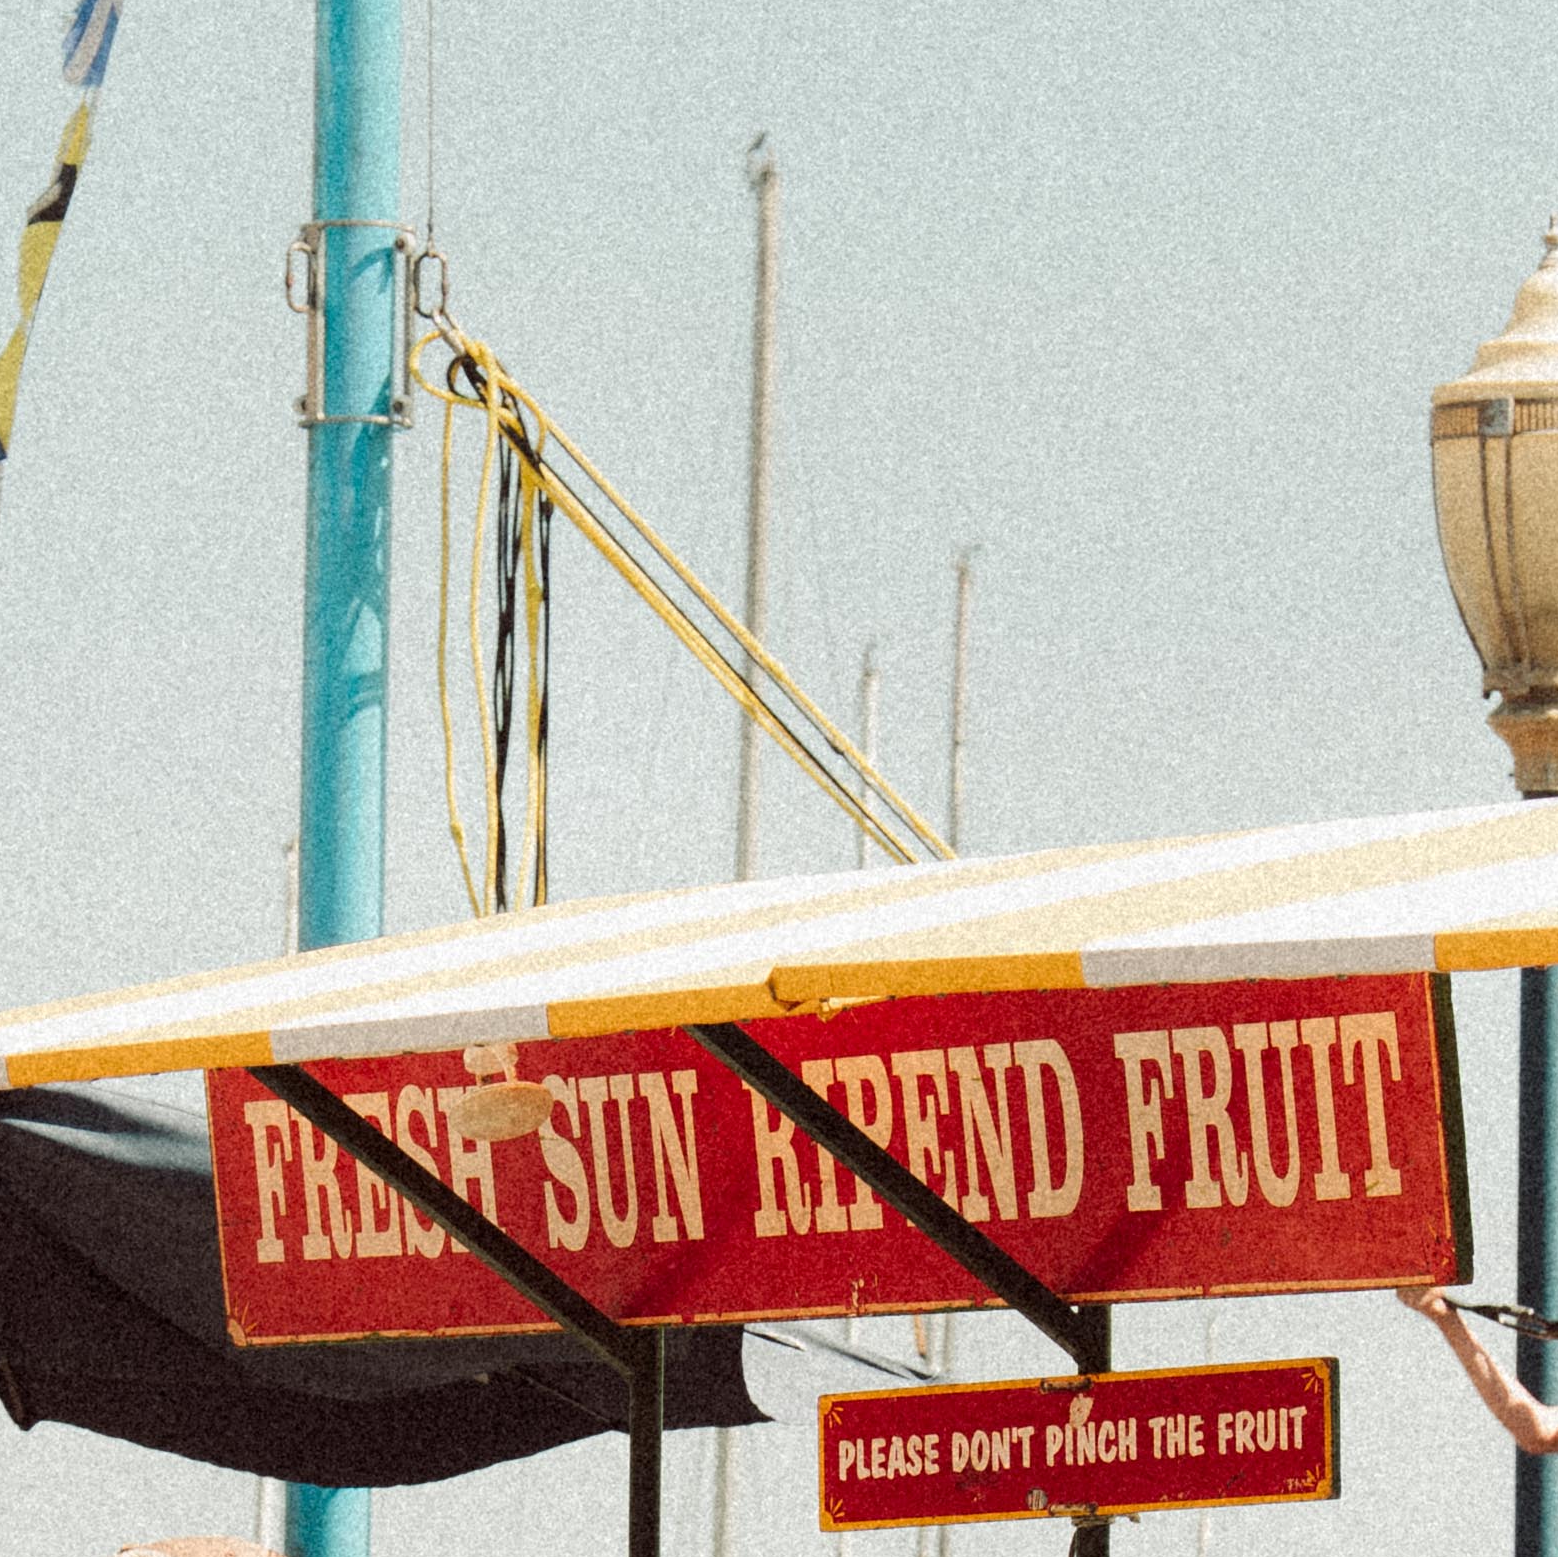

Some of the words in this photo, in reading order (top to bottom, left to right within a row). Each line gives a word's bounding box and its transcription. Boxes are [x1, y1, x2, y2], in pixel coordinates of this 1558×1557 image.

[244, 1084, 506, 1264] FRESH
[539, 1069, 705, 1252] SUN
[741, 1038, 1085, 1239] RIPEND
[1113, 1011, 1403, 1213] FRUIT
[838, 1433, 940, 1482] PLEASE
[951, 1426, 1035, 1474] DON'T
[1045, 1417, 1138, 1466] PINCH
[1148, 1413, 1206, 1460] THE
[1217, 1406, 1308, 1455] FRUIT
